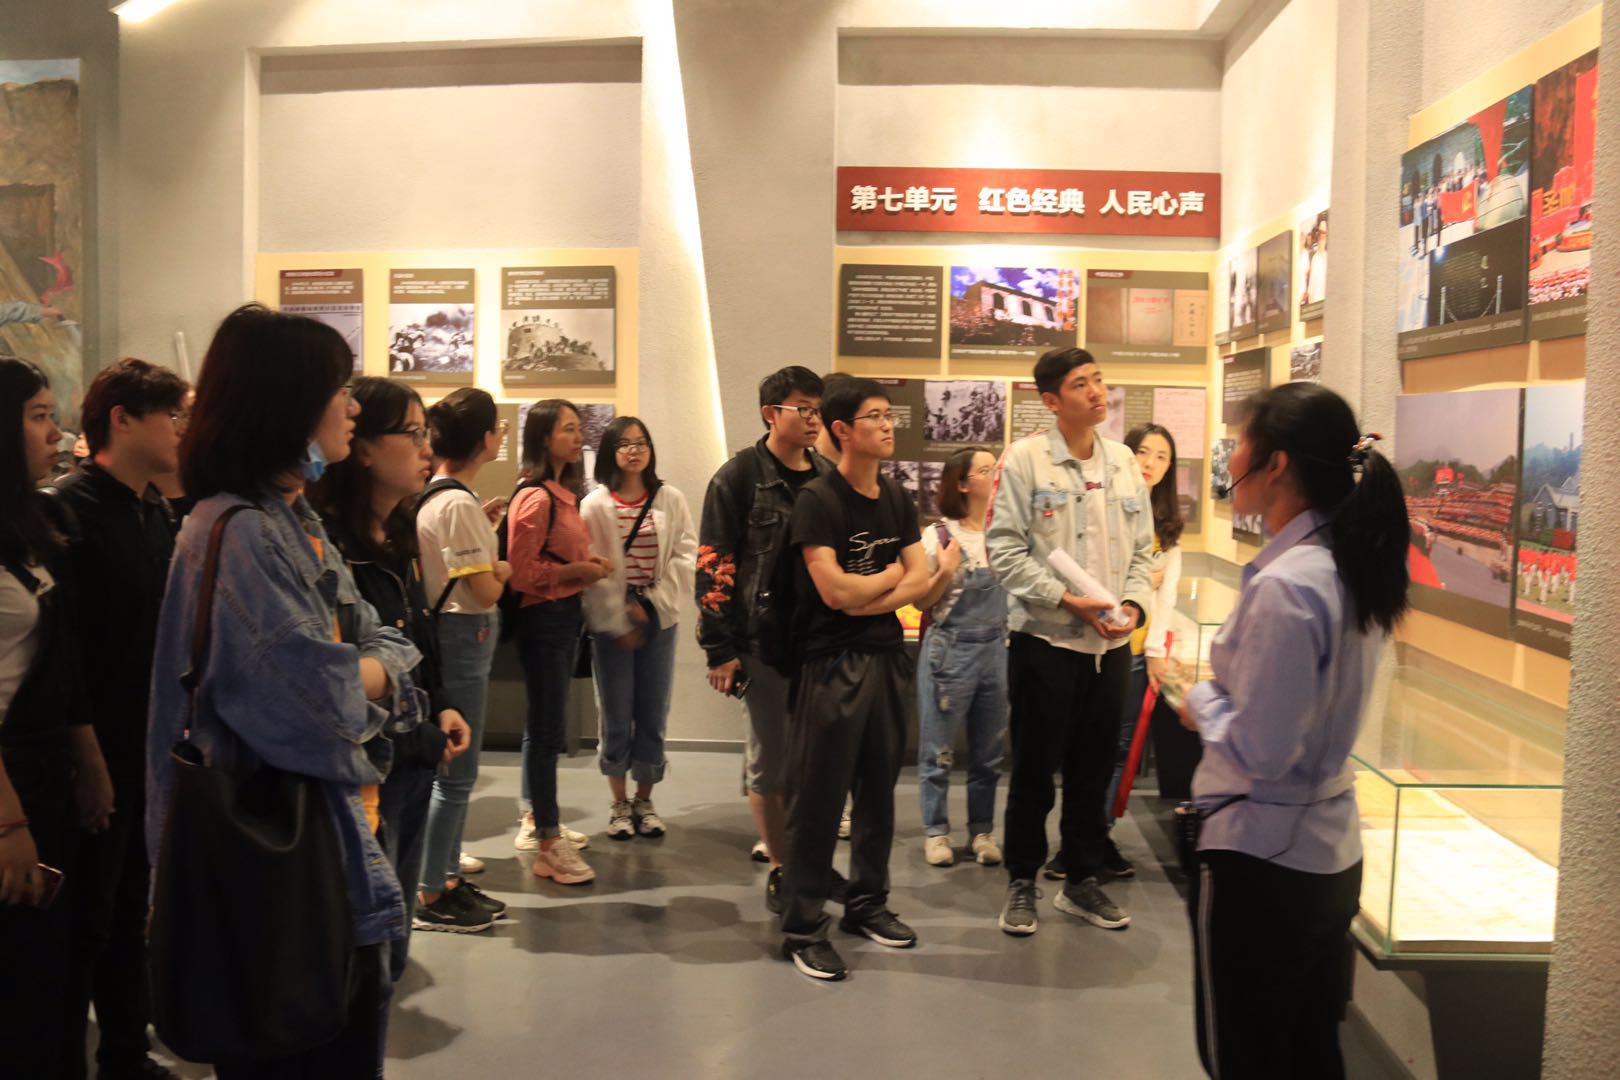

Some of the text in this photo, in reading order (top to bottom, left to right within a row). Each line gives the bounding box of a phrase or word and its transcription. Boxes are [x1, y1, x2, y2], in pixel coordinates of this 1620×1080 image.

[850, 185, 1206, 217] 第七单元 红色经典 人民心声
